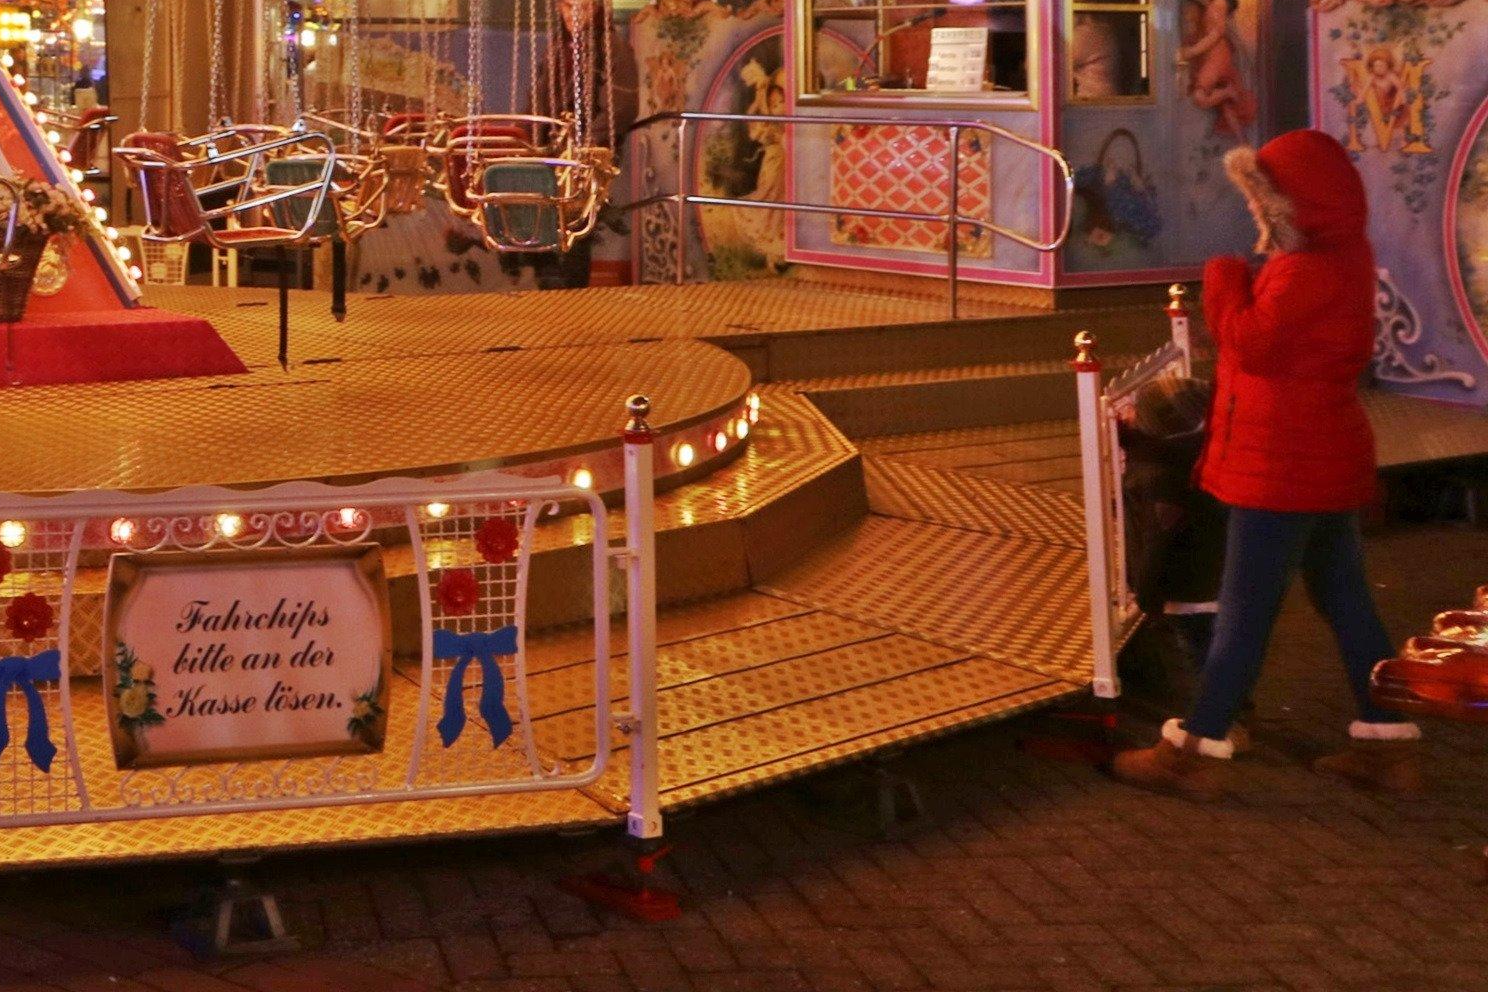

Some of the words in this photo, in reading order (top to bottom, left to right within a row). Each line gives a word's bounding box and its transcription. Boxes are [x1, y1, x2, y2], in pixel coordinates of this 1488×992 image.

[175, 598, 330, 639] Fahrchips
[173, 642, 234, 675] bitte
[241, 653, 280, 671] an
[290, 640, 335, 670] der
[165, 684, 257, 718] Kasse
[264, 681, 343, 716] lösen.
